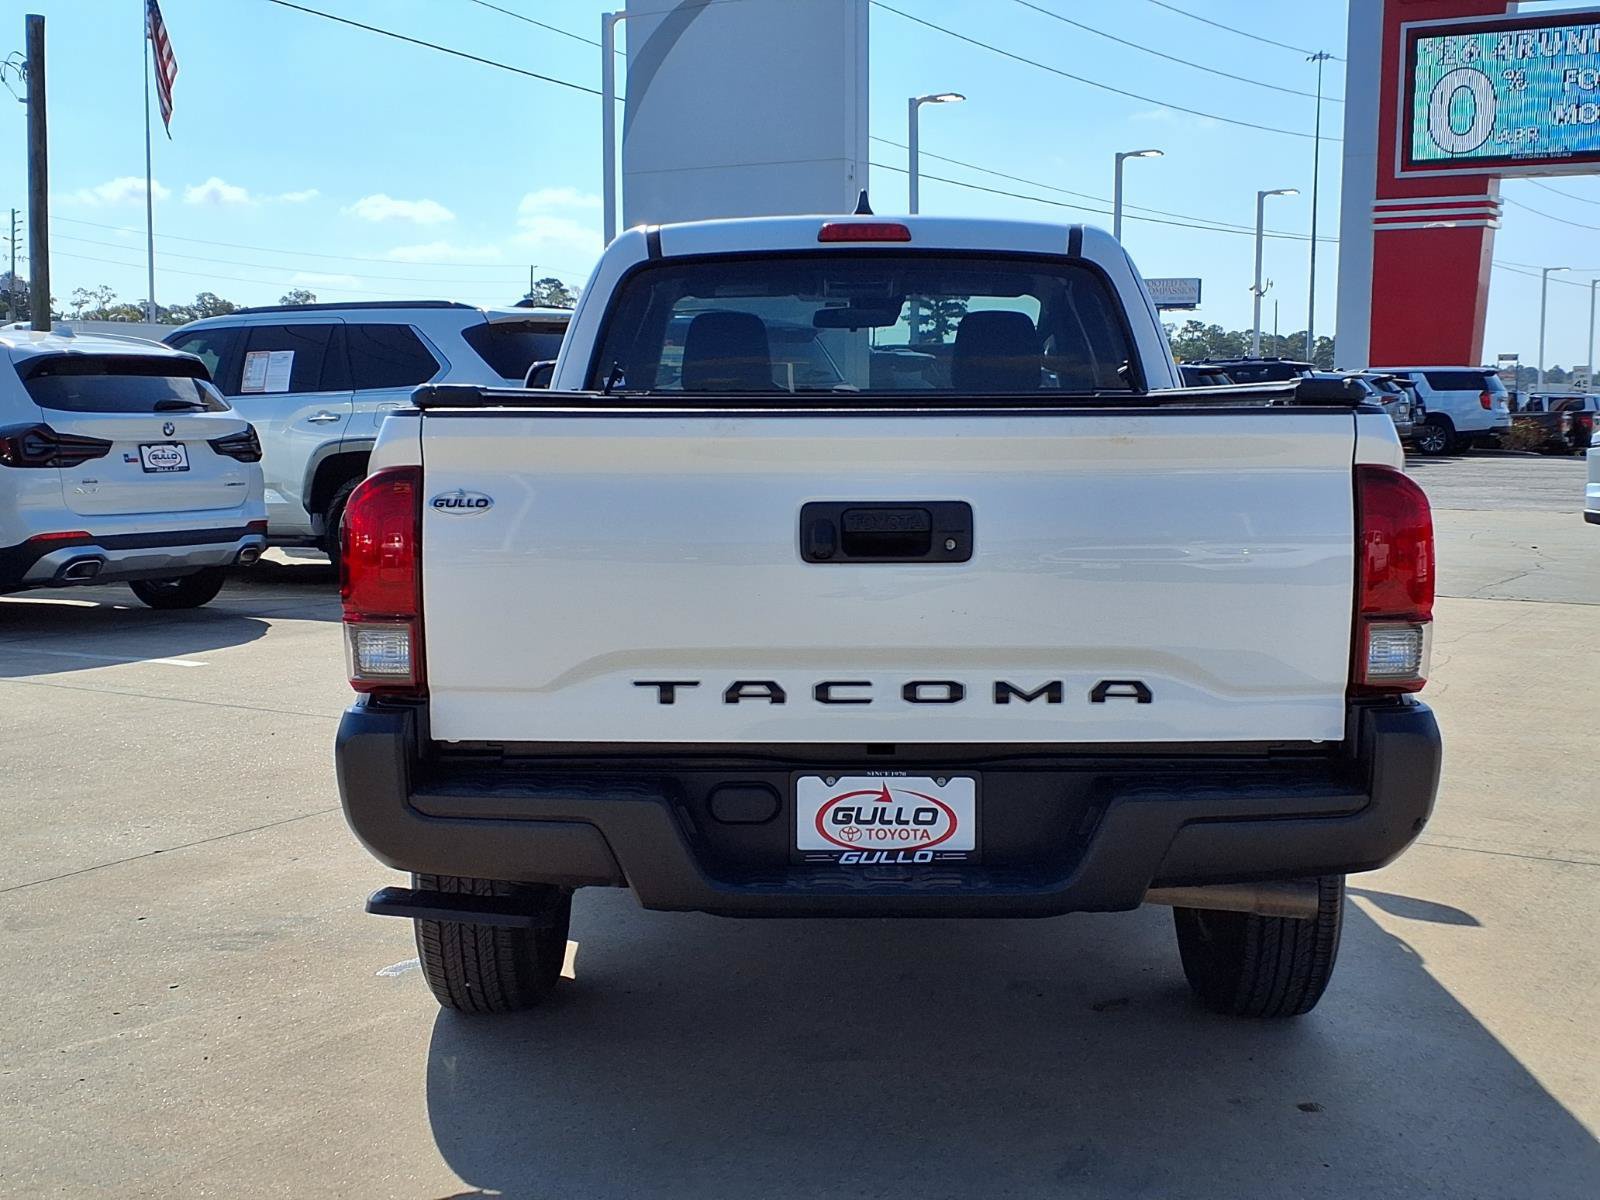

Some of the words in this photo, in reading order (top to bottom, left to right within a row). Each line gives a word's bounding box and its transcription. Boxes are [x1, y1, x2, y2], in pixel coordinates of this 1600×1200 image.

[1428, 67, 1497, 154] 0
[1147, 287, 1197, 296] OMPASSION
[433, 498, 489, 508] GULLO
[633, 679, 1154, 705] TACOMA
[831, 806, 939, 826] GULLO
[865, 828, 932, 841] TOYOTA
[838, 850, 934, 865] GULLO
